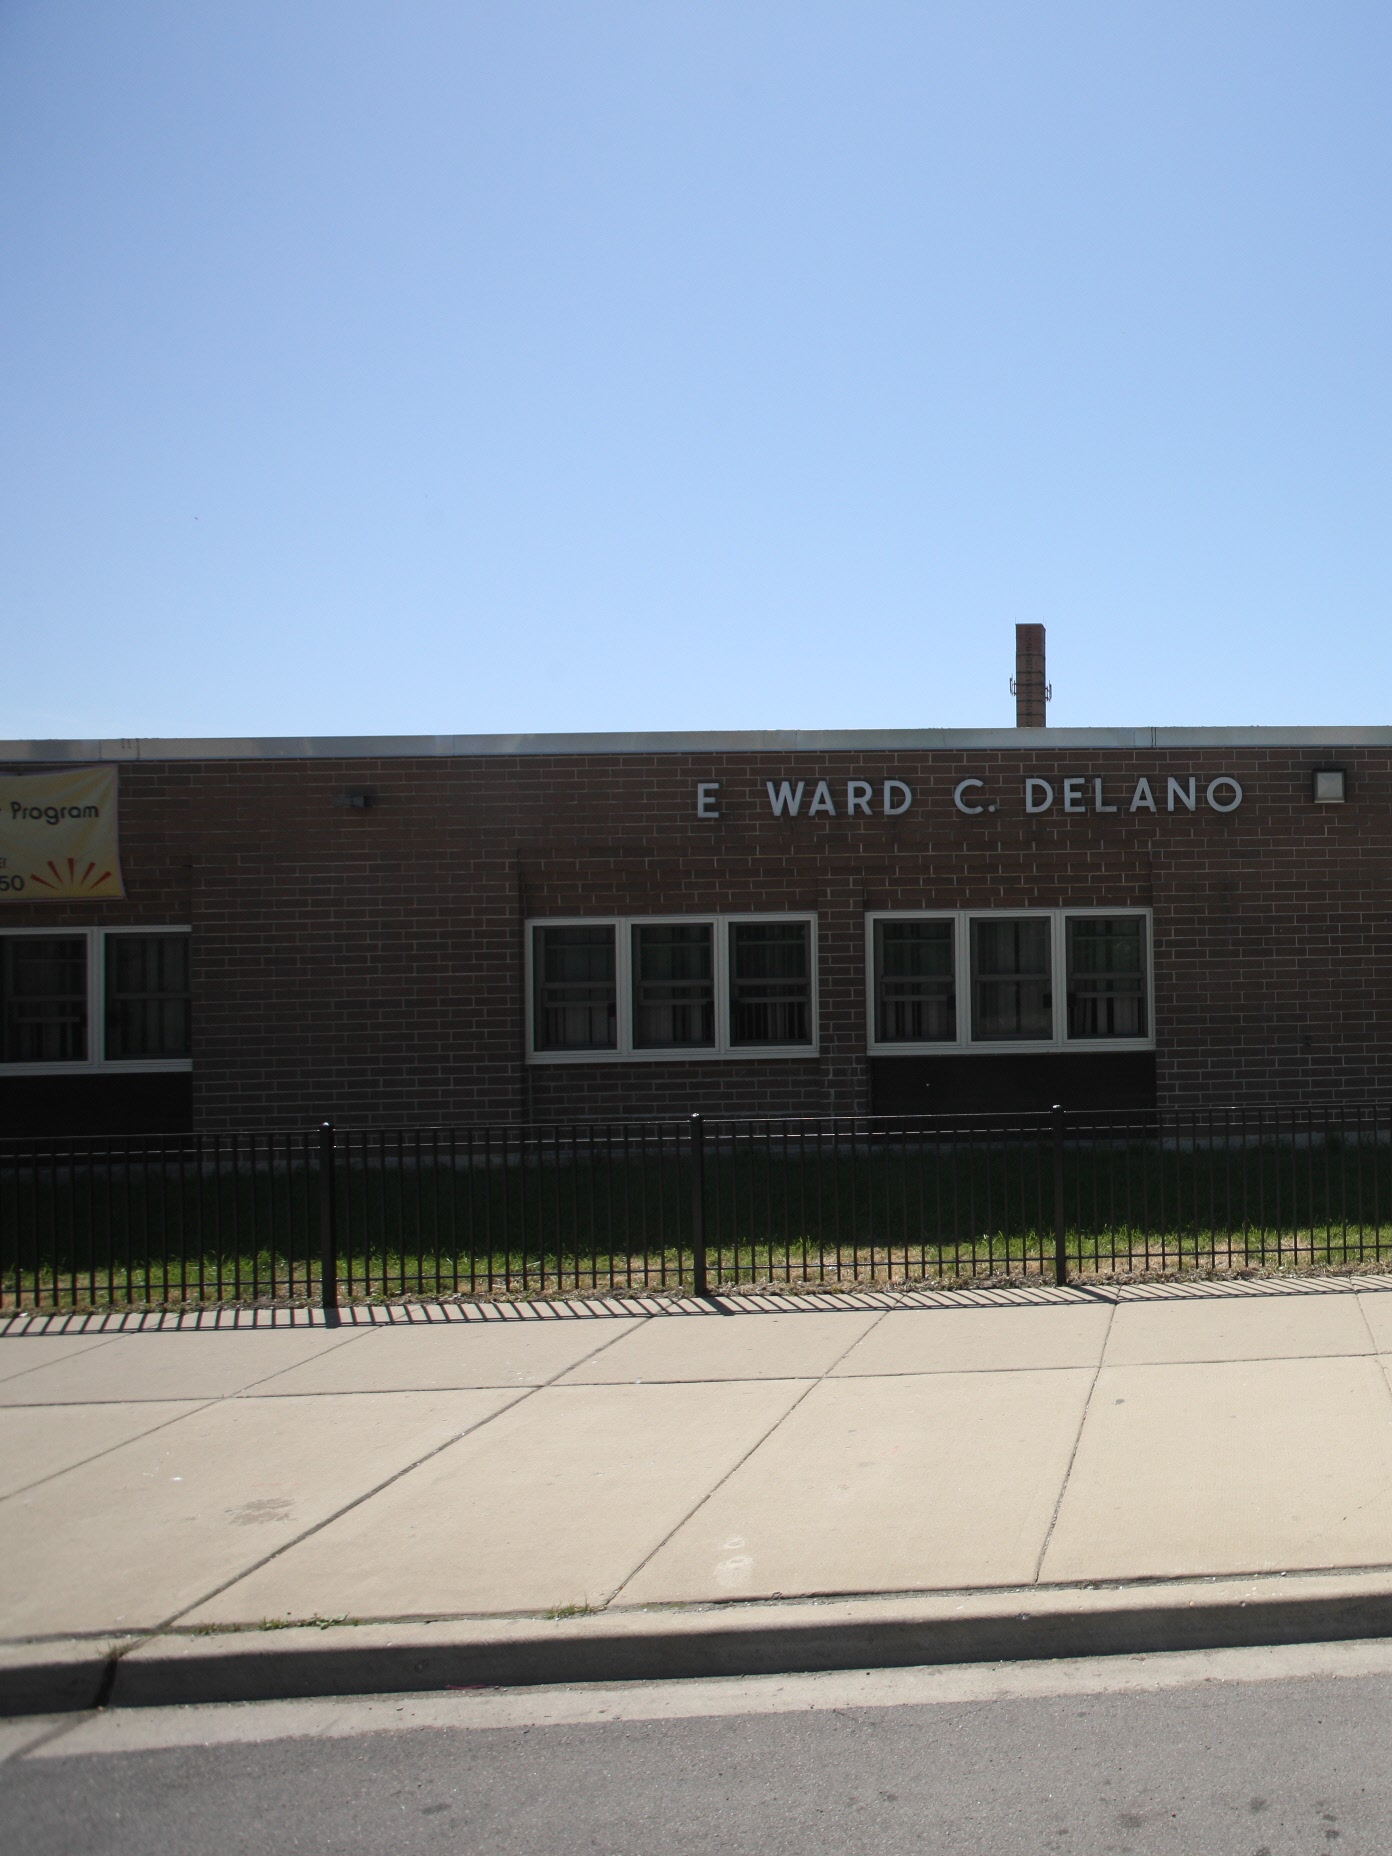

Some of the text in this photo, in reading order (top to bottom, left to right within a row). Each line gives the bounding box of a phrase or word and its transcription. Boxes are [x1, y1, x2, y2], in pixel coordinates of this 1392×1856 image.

[766, 780, 912, 816] WARD
[953, 778, 997, 814] C.
[1025, 776, 1243, 814] DELANO
[10, 801, 99, 825] Program
